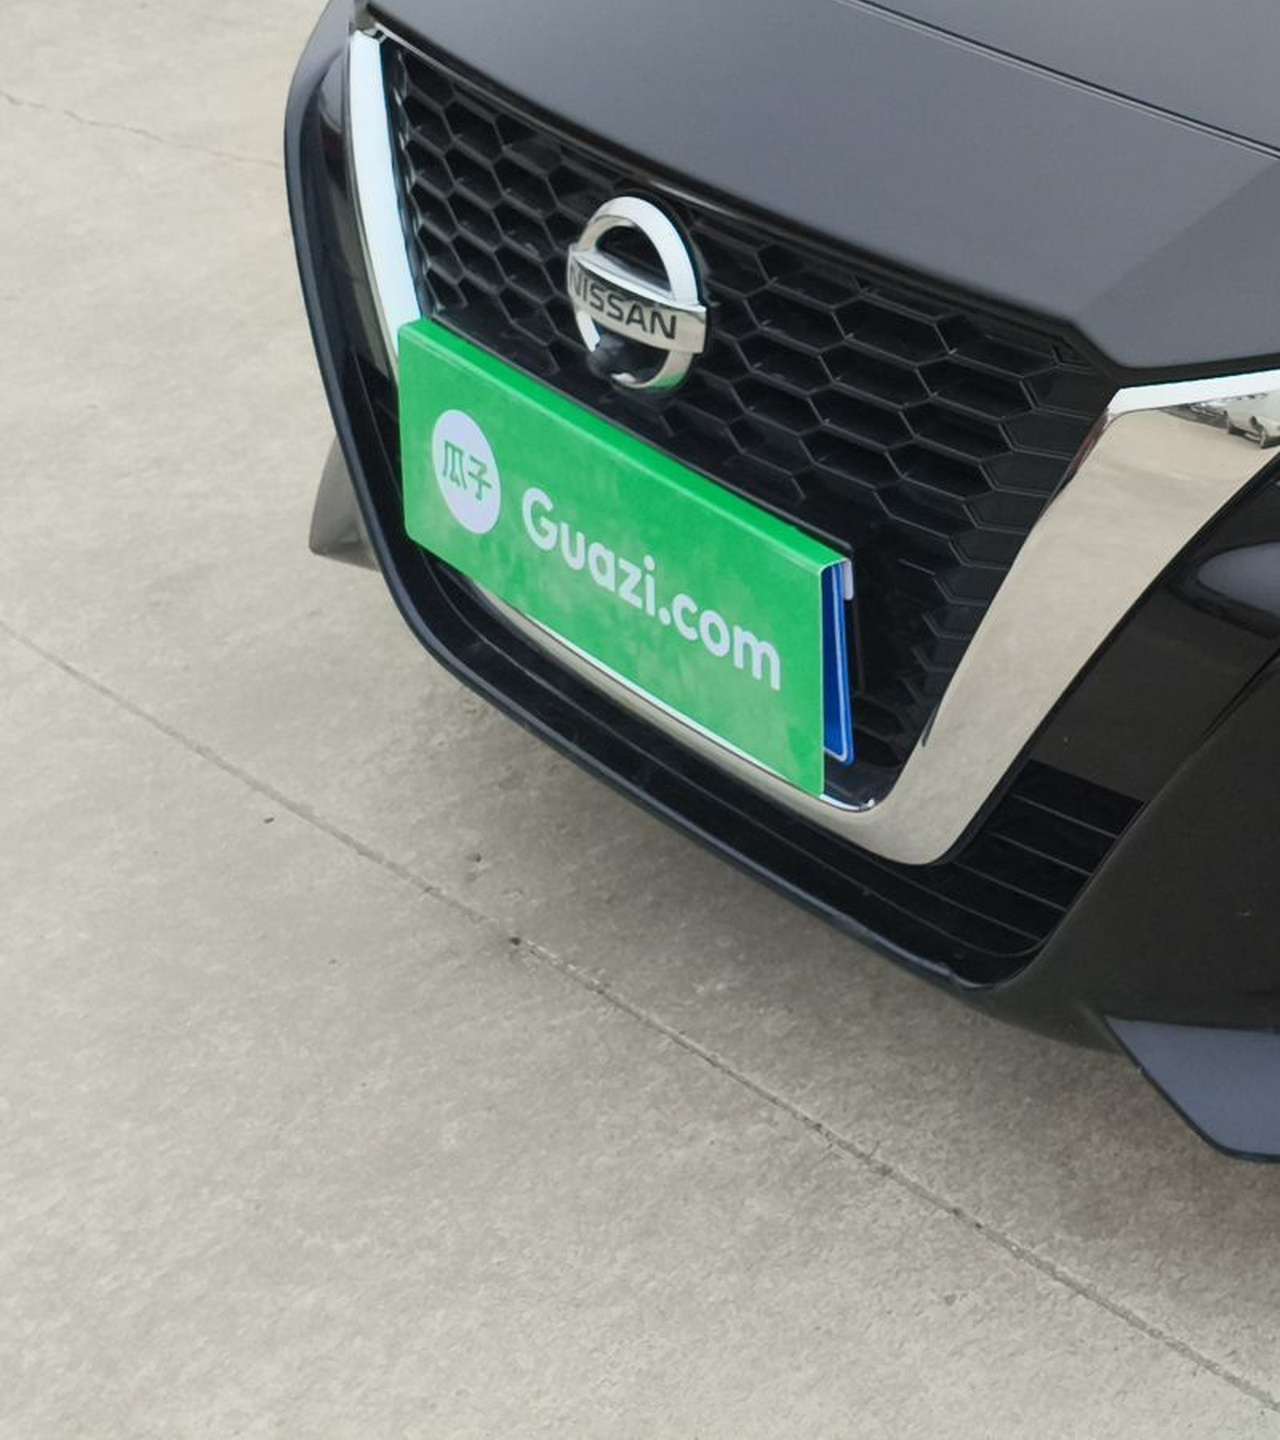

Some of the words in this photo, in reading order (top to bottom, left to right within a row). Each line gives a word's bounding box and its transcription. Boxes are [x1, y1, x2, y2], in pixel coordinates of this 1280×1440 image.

[569, 264, 679, 340] NISSAN
[441, 439, 493, 503] 瓜子
[521, 486, 782, 691] Guazi.com
